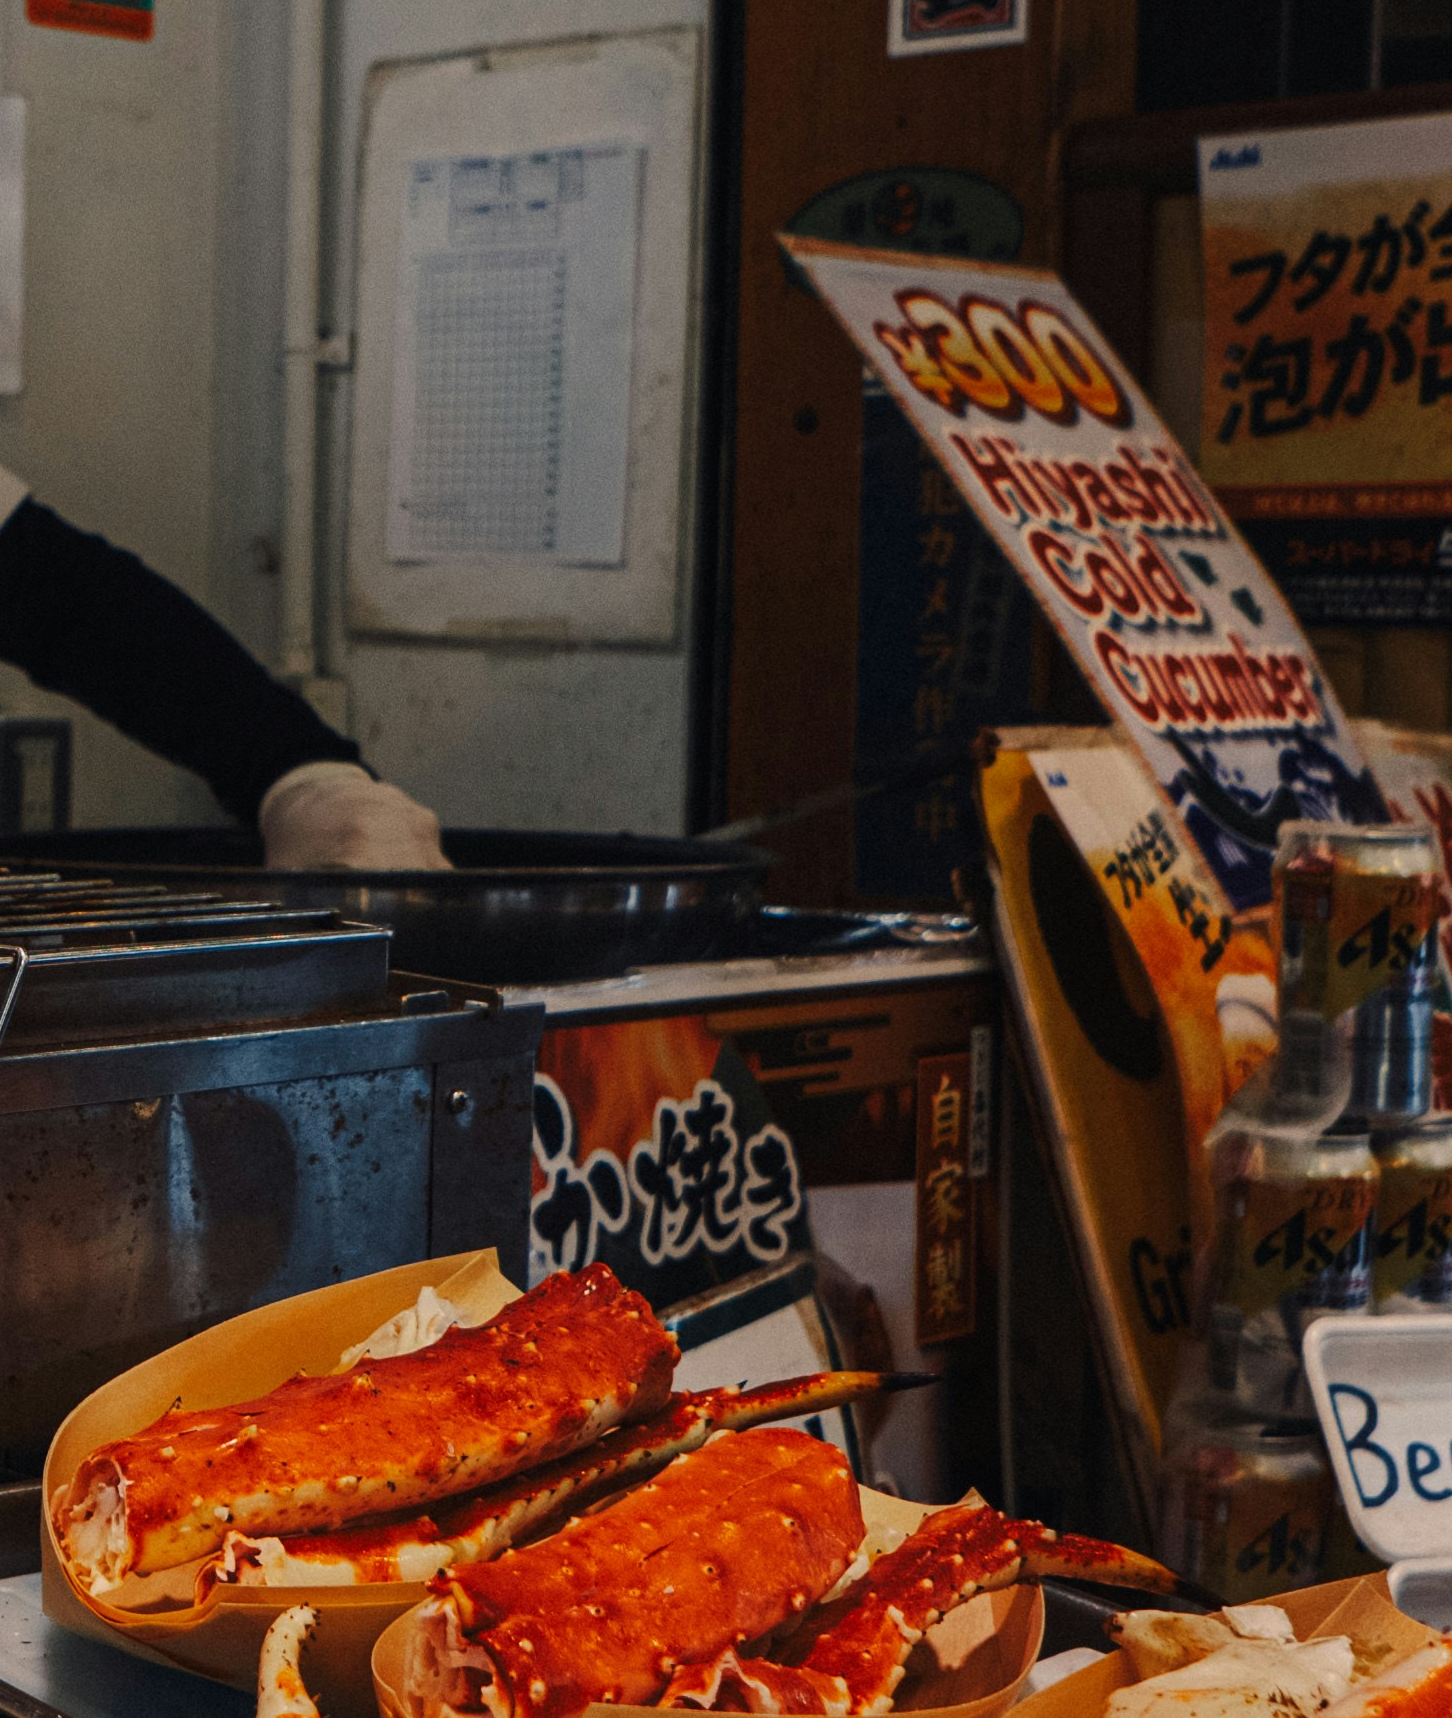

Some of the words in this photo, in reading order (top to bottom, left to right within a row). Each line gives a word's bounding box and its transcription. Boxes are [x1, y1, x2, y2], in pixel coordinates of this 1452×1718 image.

[872, 285, 1134, 427] ¥300
[950, 432, 1214, 532] Hiyashi
[1027, 529, 1200, 619] Cold
[913, 438, 960, 843] 犯カメラ作中
[1094, 630, 1312, 724] Cucumber
[929, 1074, 966, 1322] 自家製
[1327, 1382, 1452, 1509] Be
